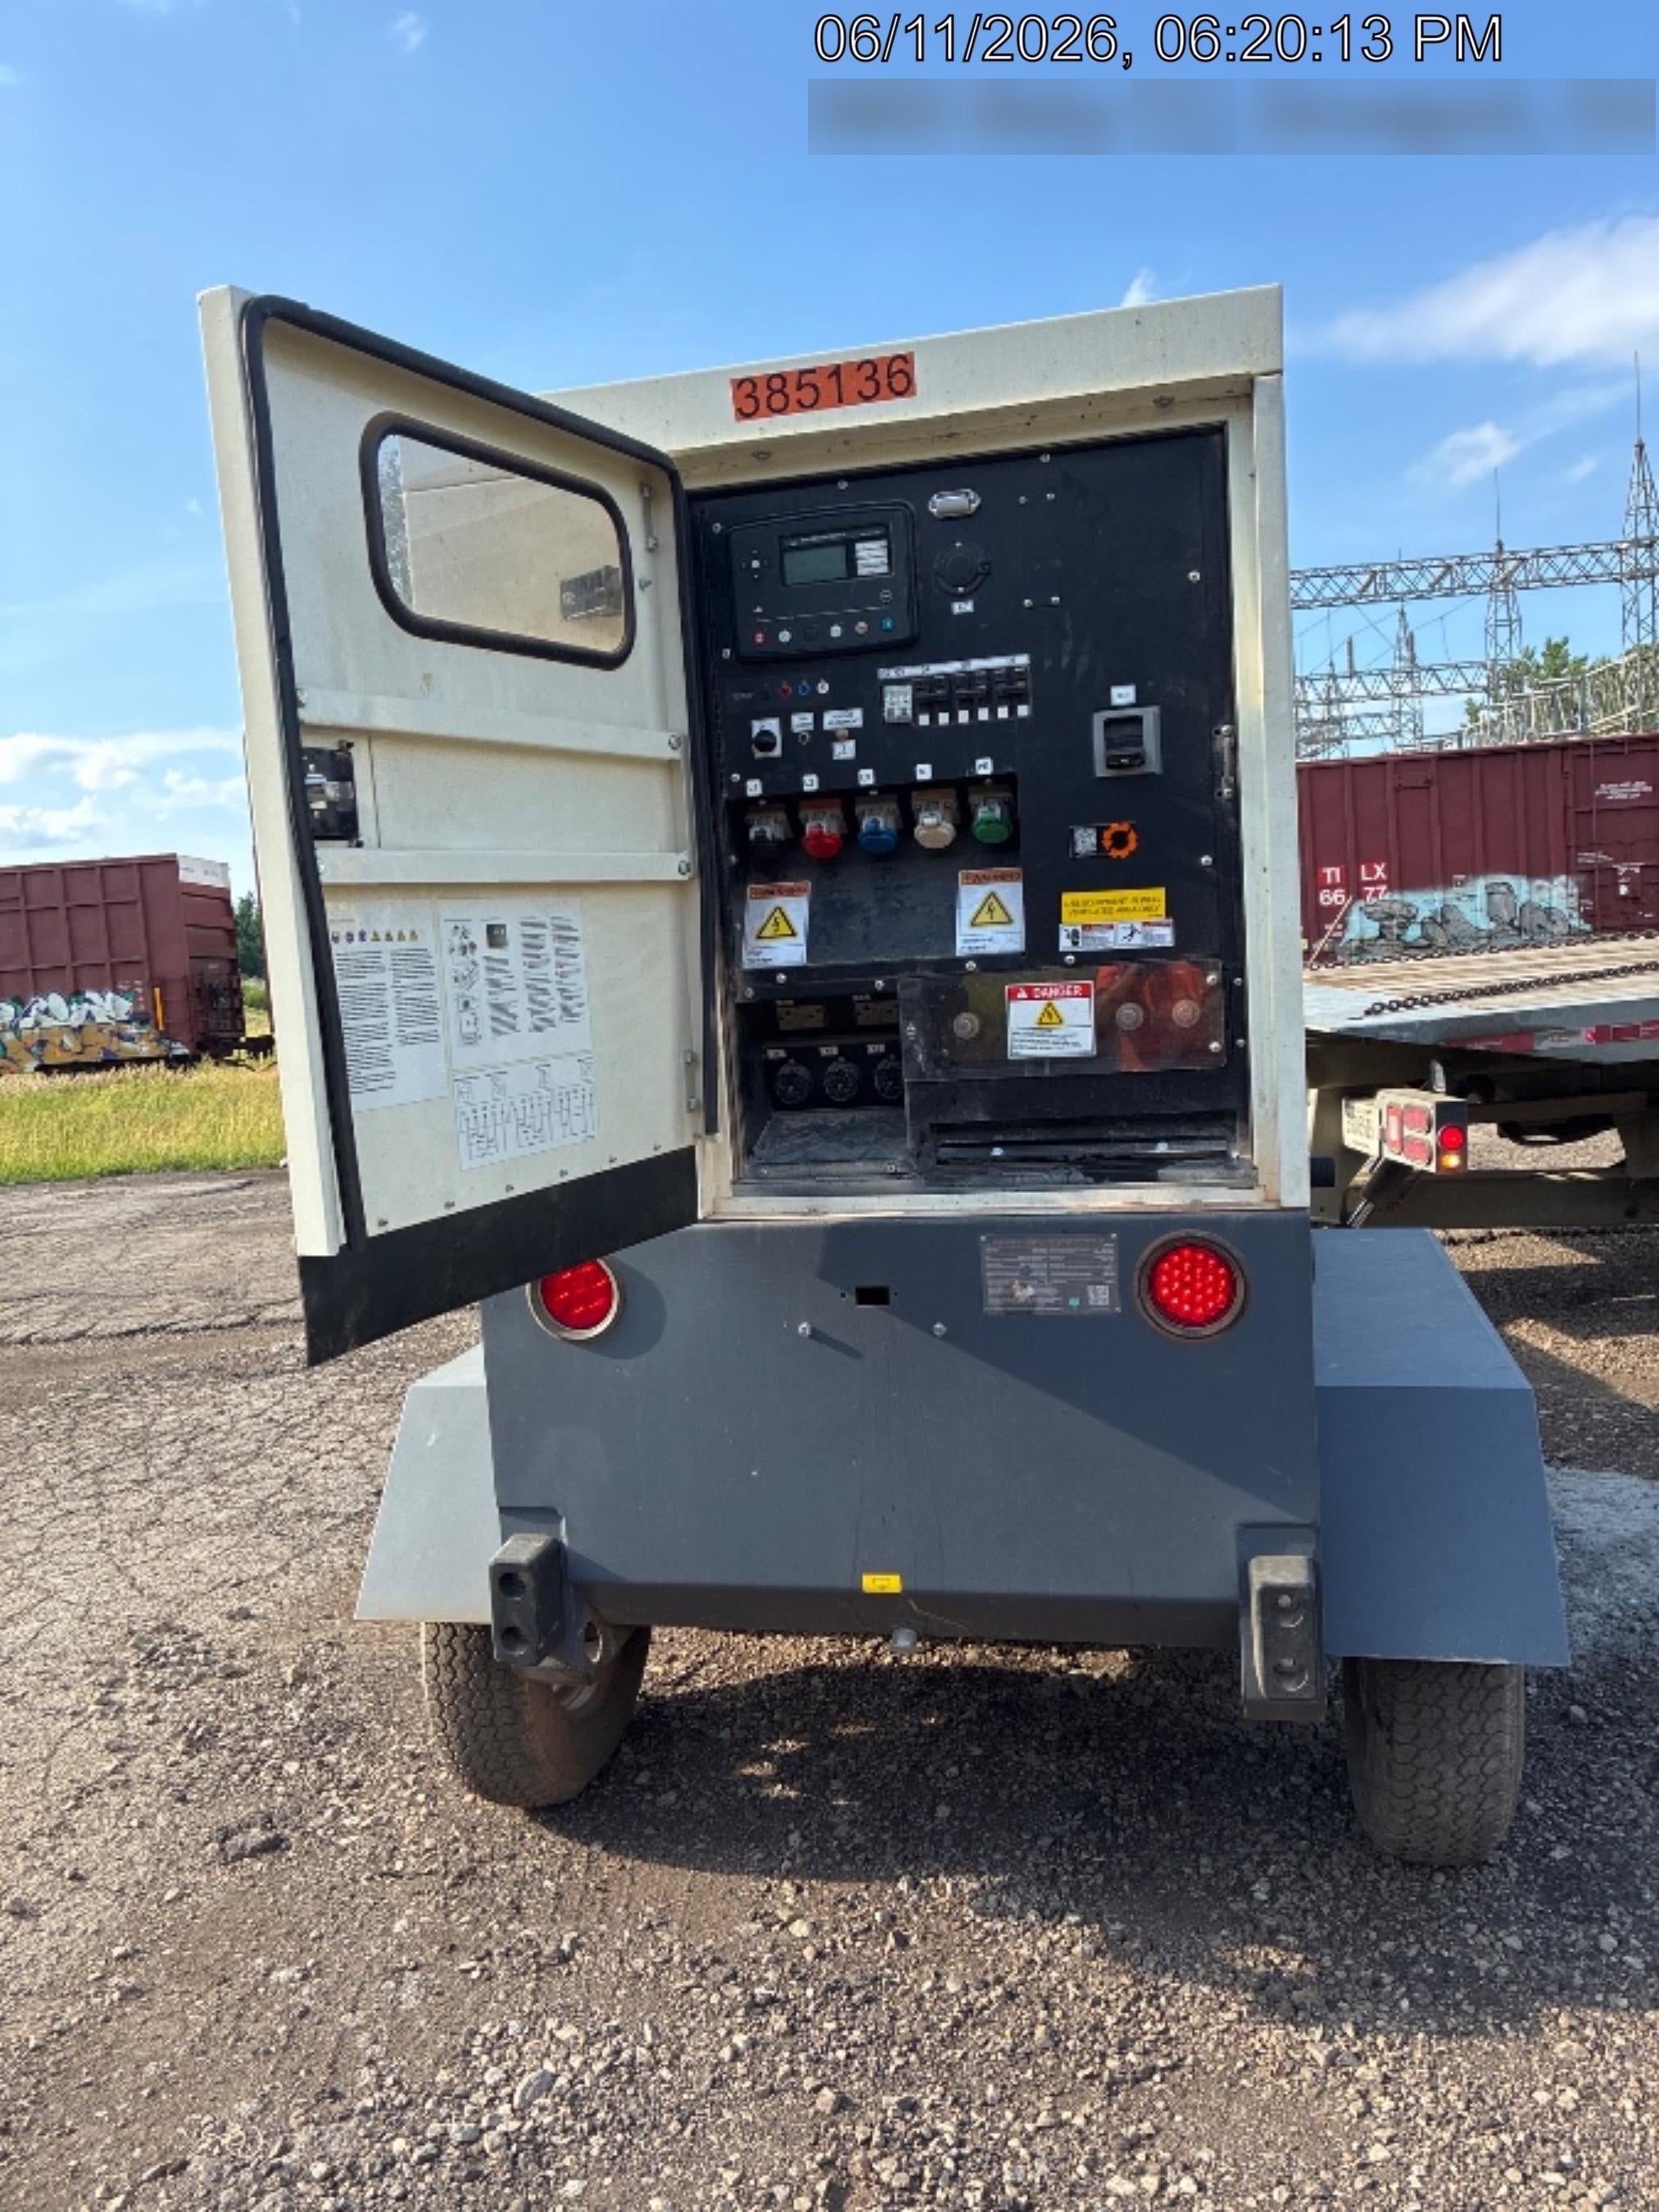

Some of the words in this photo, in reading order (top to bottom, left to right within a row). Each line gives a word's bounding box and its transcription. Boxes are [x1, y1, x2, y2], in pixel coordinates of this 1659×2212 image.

[736, 353, 913, 418] 385136
[1361, 862, 1387, 881] LX
[1319, 888, 1345, 906] 66
[1032, 985, 1083, 999] DANGER
